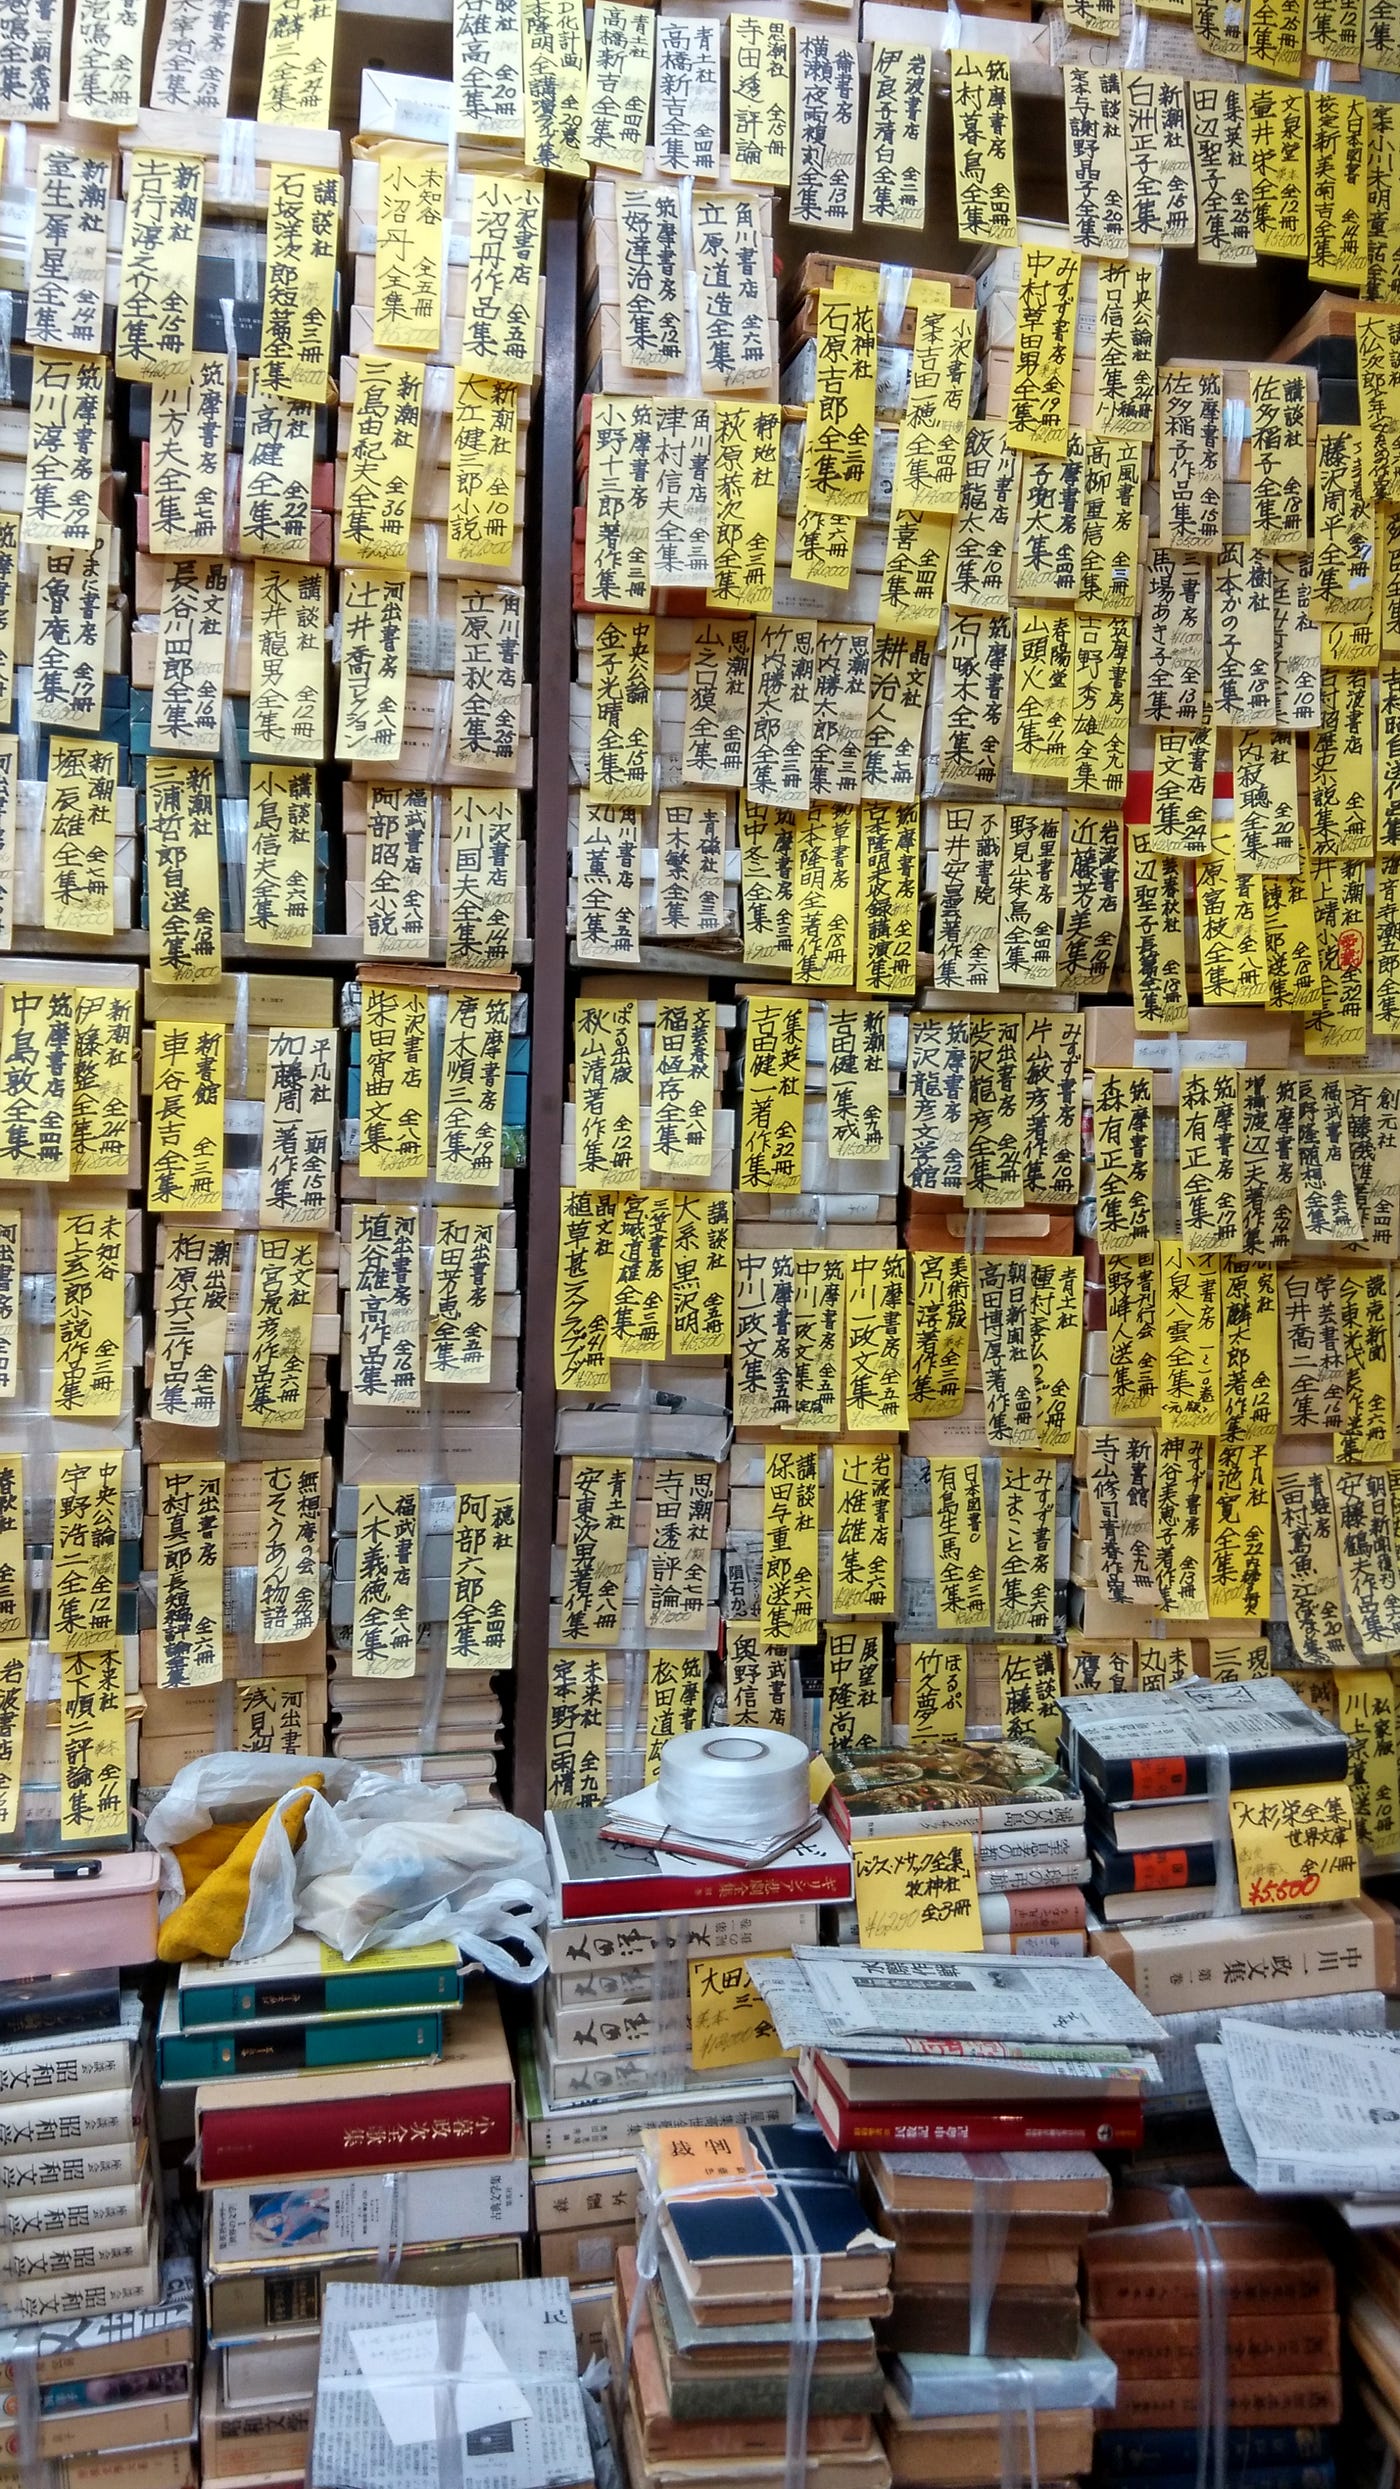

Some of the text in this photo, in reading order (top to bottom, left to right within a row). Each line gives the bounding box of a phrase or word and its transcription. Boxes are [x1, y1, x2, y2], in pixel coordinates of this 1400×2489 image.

[587, 8, 630, 149] 高橋新吉全集
[660, 23, 692, 169] 高橋新吉全集
[693, 26, 716, 85] 青土社
[769, 23, 790, 79] 思潮社
[901, 53, 927, 140] 岩波書店
[984, 59, 1011, 159] 筑摩書房
[1100, 73, 1122, 139] 講談社
[1159, 82, 1186, 149] 新潮社
[1222, 90, 1248, 167] 集英社
[1279, 93, 1302, 163] 文泉堂
[78, 158, 109, 234] 新潮社
[953, 55, 989, 235] 山村暮鳥全集
[1127, 76, 1163, 234] 白洲正子全集
[1192, 88, 1230, 248] 田辺聖子全集
[27, 149, 78, 343] 室生犀星全集
[118, 158, 171, 362] 吉行淳之介全集
[156, 162, 200, 353] 新潮社 全15冊
[297, 178, 338, 363] 講談社 全三冊
[375, 166, 416, 323] 小沼丹全集
[412, 168, 442, 318] 未知谷 全五冊
[465, 184, 512, 357] 小沼丹作品集
[510, 188, 540, 286] 小沢書店
[621, 191, 658, 351] 三好達治全集
[654, 196, 680, 302] 筑摩書房
[698, 202, 735, 373] 立原道造全集
[735, 202, 760, 300] 角川書店
[851, 305, 875, 380] 花神社
[1008, 250, 1052, 432] 中村草田男全集
[1098, 264, 1130, 399] 折口信夫全集
[1130, 271, 1153, 362] 中央公論社
[28, 362, 70, 520] 石川淳全集
[70, 364, 101, 480] 筑摩書房
[343, 363, 387, 542] 三島由紀夫全集
[389, 372, 423, 448] 新潮社
[450, 373, 488, 542] 大江健三郎小説
[810, 303, 848, 493] 石原吉郎全集
[1162, 372, 1198, 536] 佐多稲子作品集
[1252, 376, 1285, 532] 佐多稲子全集
[592, 404, 629, 600] 小野十三郎著作集
[652, 407, 689, 573] 津村信夫全集
[955, 426, 993, 595] 飯田龍太全集
[1081, 438, 1112, 602] 高柳重信全集
[1111, 443, 1139, 531] 立風書房
[1313, 430, 1352, 601] 藤沢周平全集
[159, 560, 199, 738] 長谷川四郎全集
[198, 563, 228, 635] 晶文社
[252, 570, 292, 742] 永井龍男全集
[296, 575, 323, 650] 講談社
[343, 581, 378, 749] 辻井喬コレクション
[378, 580, 404, 677] 河出書房
[459, 590, 494, 753] 立原正秋全集
[1047, 618, 1072, 690] 春陽堂
[1143, 549, 1176, 722] 馬場あき子全集
[1213, 542, 1247, 712] 岡本かの子全集
[593, 623, 627, 785] 金子光晴全集
[751, 627, 793, 795] 竹内勝太郎全集
[810, 632, 848, 794] 竹内勝太郎全集
[862, 633, 907, 785] 耕治人全集
[944, 613, 981, 766] 石川啄木全集
[1015, 617, 1050, 755] 山頭火全集
[1072, 617, 1105, 792] 吉野秀雄全集
[1343, 671, 1365, 756] 岩波書店
[50, 747, 87, 904] 堀辰雄全集
[149, 765, 191, 969] 三浦哲郎自選全集
[249, 771, 287, 930] 小島信夫全集
[368, 786, 403, 938] 阿部昭全小説
[450, 797, 487, 958] 小川国夫全集
[579, 805, 616, 945] 丸山薫全集
[659, 806, 692, 930] 田木繁全集
[743, 802, 776, 934] 田中冬二全集
[794, 802, 829, 983] 吉本隆明全著作集
[1002, 815, 1039, 972] 野見山朱鳥全集
[1059, 818, 1100, 974] 近藤芳美集
[1, 991, 43, 1158] 中島敦全集
[71, 996, 104, 1154] 伊藤整全集
[152, 1029, 189, 1202] 車谷長吉全集
[192, 1031, 221, 1105] 新書館
[266, 1032, 306, 1209] 加藤周一著作集
[309, 1038, 332, 1105] 平凡社
[363, 990, 399, 1154] 柴田宵曲文集
[443, 995, 479, 1162] 唐木順三全集
[577, 1008, 610, 1172] 秋山清著作集
[653, 1006, 690, 1155] 福田恆存全集
[742, 1005, 782, 1187] 吉田健一著作集
[828, 1008, 862, 1140] 吉田健一集成
[905, 1021, 944, 1189] 渋沢龍彦文学館
[967, 1020, 997, 1194] 渋沢龍彦全集
[1022, 1018, 1055, 1193] 片山敏彦著作集
[1128, 1079, 1151, 1181] 筑摩書房
[1097, 1073, 1130, 1232] 森有正全集
[1182, 1073, 1216, 1230] 森有正全集
[156, 1233, 205, 1415] 柏原兵三作品集
[201, 1240, 233, 1310] 潮出版
[247, 1238, 290, 1415] 田宮虎彦作品集
[354, 1213, 393, 1395] 埴谷雄高作品集
[433, 1219, 468, 1371] 和田芳恵全集
[609, 1193, 650, 1339] 宮城道雄全集
[735, 1251, 768, 1393] 中川一政文集
[845, 1253, 880, 1410] 中川一政文集
[909, 1254, 946, 1402] 宮川淳著作集
[1164, 1249, 1195, 1397] 小泉八雲全集
[977, 1261, 1011, 1441] 高田博厚著作集
[55, 1464, 92, 1634] 宇野浩二全集
[262, 1467, 293, 1629] むそうあん物語
[358, 1494, 394, 1660] 八木義徳全集
[451, 1495, 488, 1656] 阿部六郎全集
[563, 1468, 604, 1639] 安東次男著作集
[763, 1452, 796, 1639] 保田与重郎選集
[838, 1457, 872, 1583] 辻惟雄集
[932, 1463, 965, 1614] 有島生馬全集
[1000, 1468, 1034, 1609] 辻まこと全集
[1155, 1437, 1186, 1612] 神谷美恵子著作集
[1211, 1445, 1243, 1585] 菊池寛全集
[64, 1653, 95, 1825] 木下順二評論集
[905, 1876, 961, 1898] 牧神社
[1285, 1828, 1349, 1848] 世界文庫
[1222, 1947, 1363, 1985] 中川一政文集
[342, 2114, 495, 2148] 小暮政次全歌集
